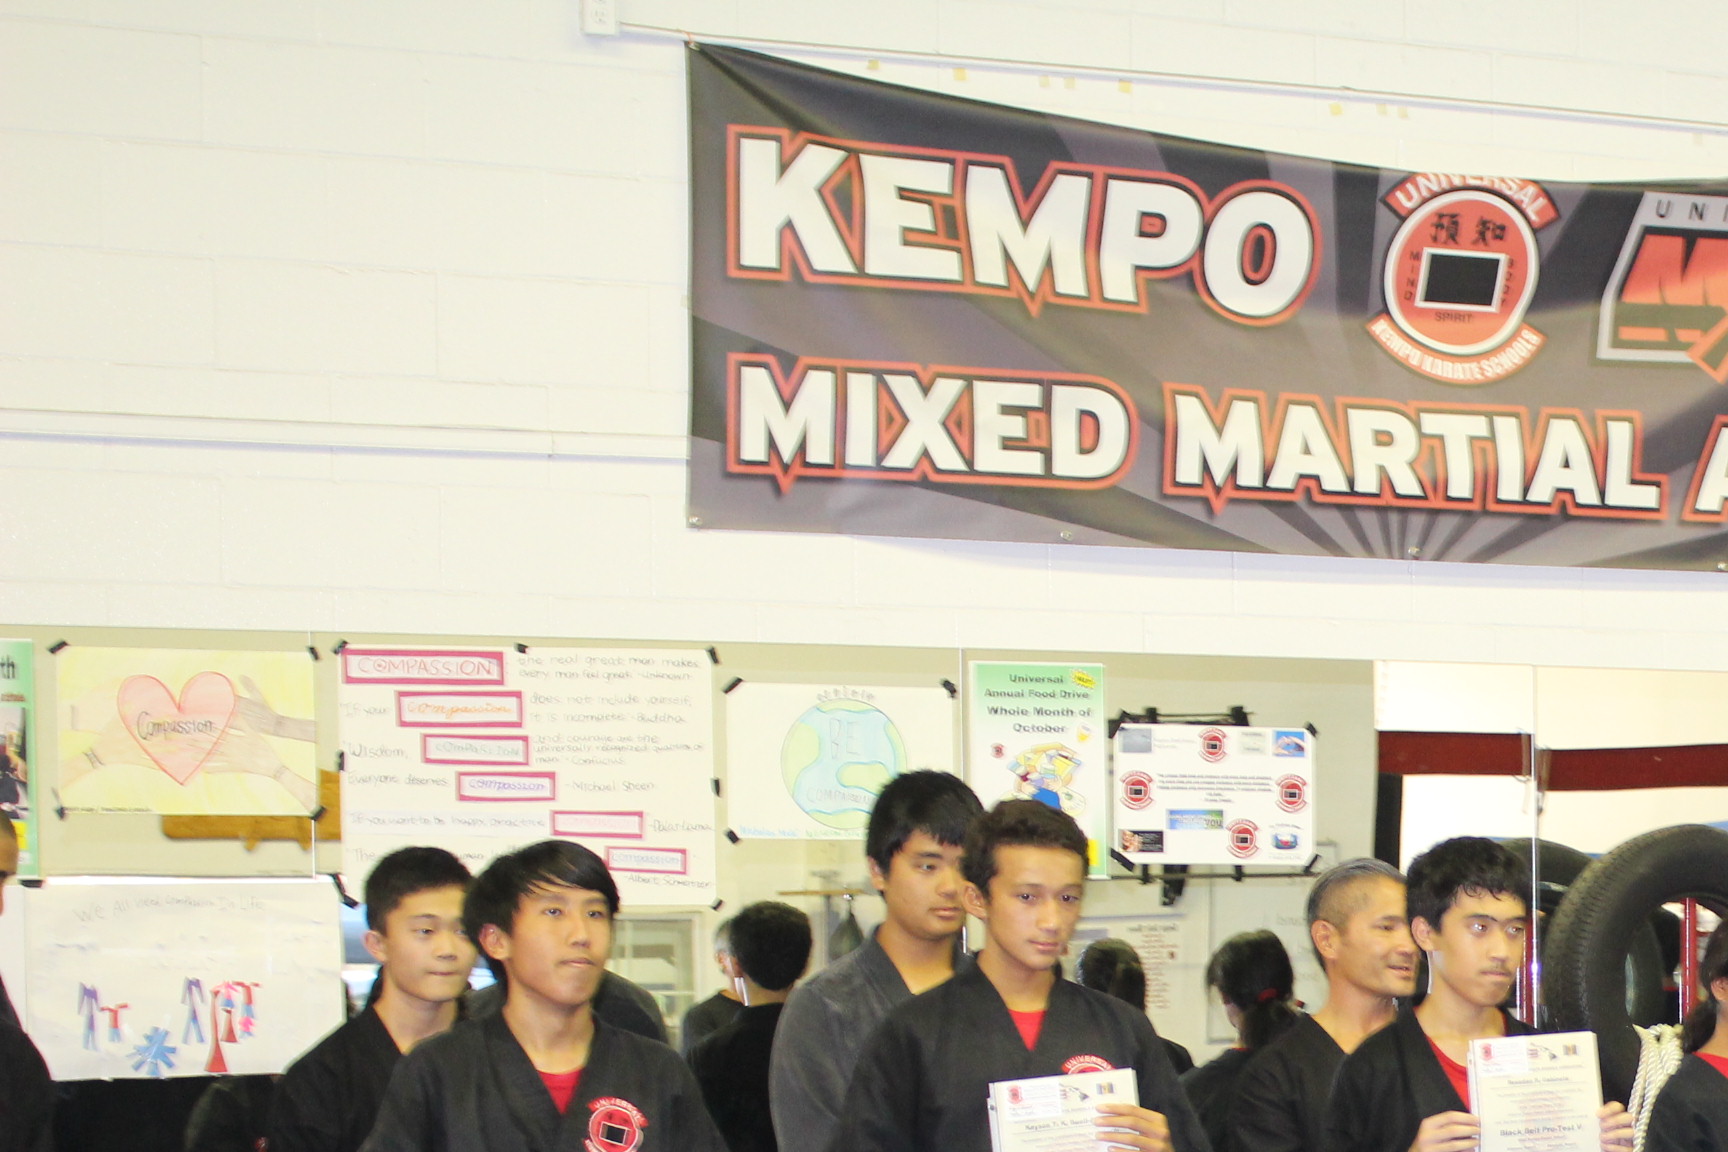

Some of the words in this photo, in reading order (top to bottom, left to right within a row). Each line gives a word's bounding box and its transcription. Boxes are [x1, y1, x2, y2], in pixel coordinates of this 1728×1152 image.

[737, 136, 1316, 318] KEMPO
[1434, 311, 1474, 323] SPIRIT
[1371, 320, 1421, 366] KEMPO
[1423, 355, 1484, 380] KARATE
[1484, 330, 1541, 377] SCHOOLS
[738, 365, 1132, 479] MIXED
[1175, 394, 1662, 509] MARTIAL
[358, 656, 493, 676] COMPASSION
[1008, 673, 1064, 684] Universal
[983, 688, 1025, 698] Annual
[1027, 688, 1056, 699] Food
[1059, 689, 1091, 699] Drive
[986, 705, 1030, 717] Whole
[1032, 706, 1075, 717] Month
[1078, 706, 1092, 717] of
[136, 710, 215, 741] Compassion
[1012, 723, 1067, 734] October
